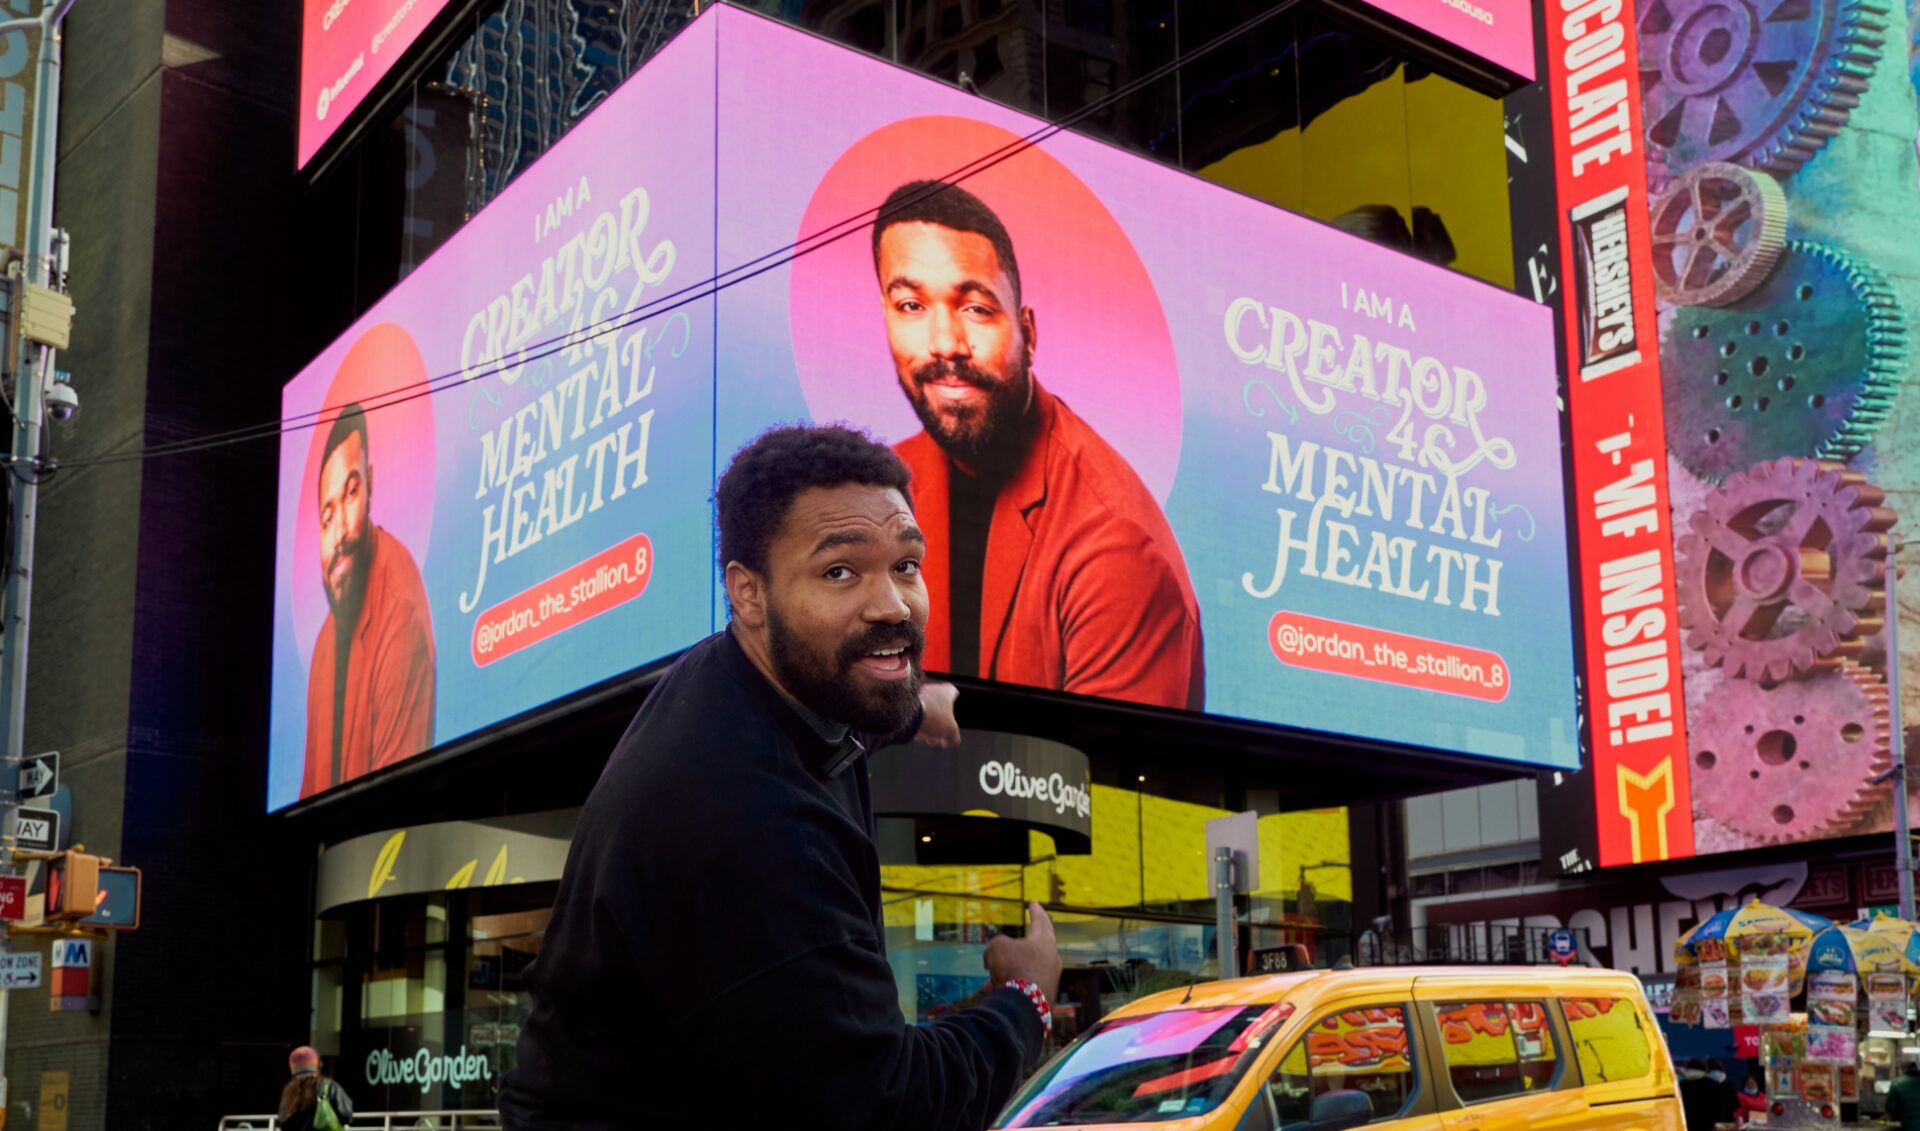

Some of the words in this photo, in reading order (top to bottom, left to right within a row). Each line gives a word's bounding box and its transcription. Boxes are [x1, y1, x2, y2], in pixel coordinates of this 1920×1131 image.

[1560, 0, 1632, 177] COLATE
[535, 213, 541, 244] I
[543, 186, 573, 237] AM
[576, 175, 591, 210] A
[461, 186, 677, 386] CREATOR
[1340, 281, 1348, 309] I
[1353, 287, 1393, 324] AM
[1397, 303, 1417, 332] A
[475, 327, 656, 500] MENTAL
[1223, 297, 1517, 477] CREATOR
[459, 408, 655, 613] HEALTH
[1261, 430, 1503, 549] MENTAL
[476, 546, 648, 655] @jordan_the_stallion_8
[1241, 498, 1504, 617] HEALTH
[1276, 623, 1505, 688] @jordan_the_stallion_8
[1600, 548, 1674, 747] INSIDE!
[16, 955, 38, 968] ZONE
[1262, 951, 1287, 971] 3F88
